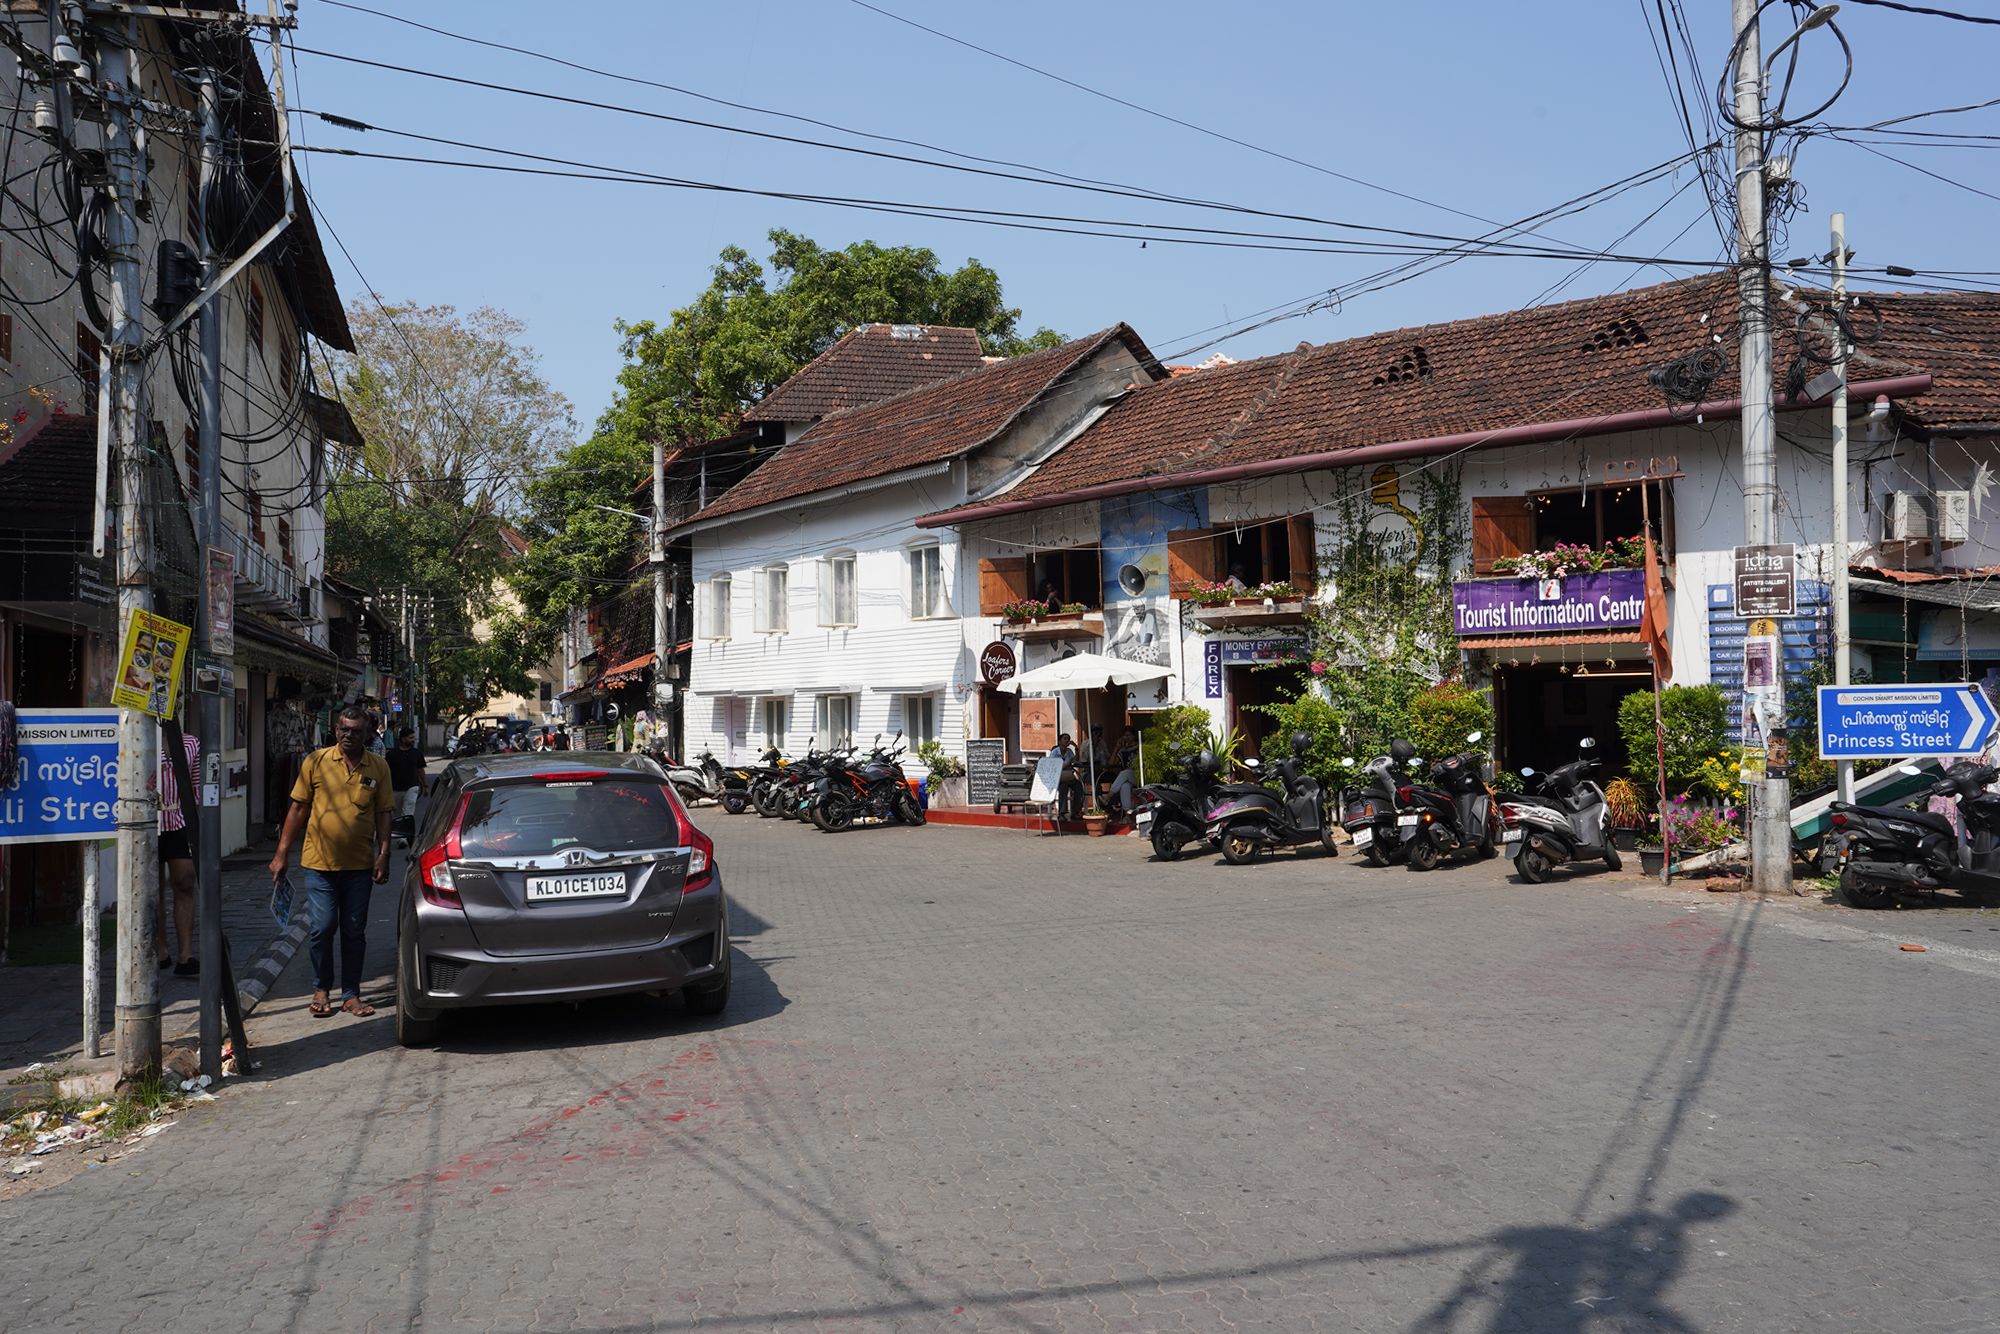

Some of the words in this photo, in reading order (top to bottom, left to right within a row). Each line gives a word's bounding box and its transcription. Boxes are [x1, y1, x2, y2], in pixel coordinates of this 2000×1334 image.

[1457, 602, 1506, 629] Tourist
[1510, 599, 1595, 626] Information
[1226, 641, 1255, 651] MONEY
[982, 652, 1010, 667] Loafers
[989, 665, 1014, 680] Corner
[1207, 644, 1219, 695] FOREX
[17, 730, 68, 739] MISSION
[70, 729, 116, 738] LIMITED
[1828, 733, 1894, 748] Princess
[1901, 732, 1952, 747] Street
[536, 876, 624, 895] KL01CE1034
